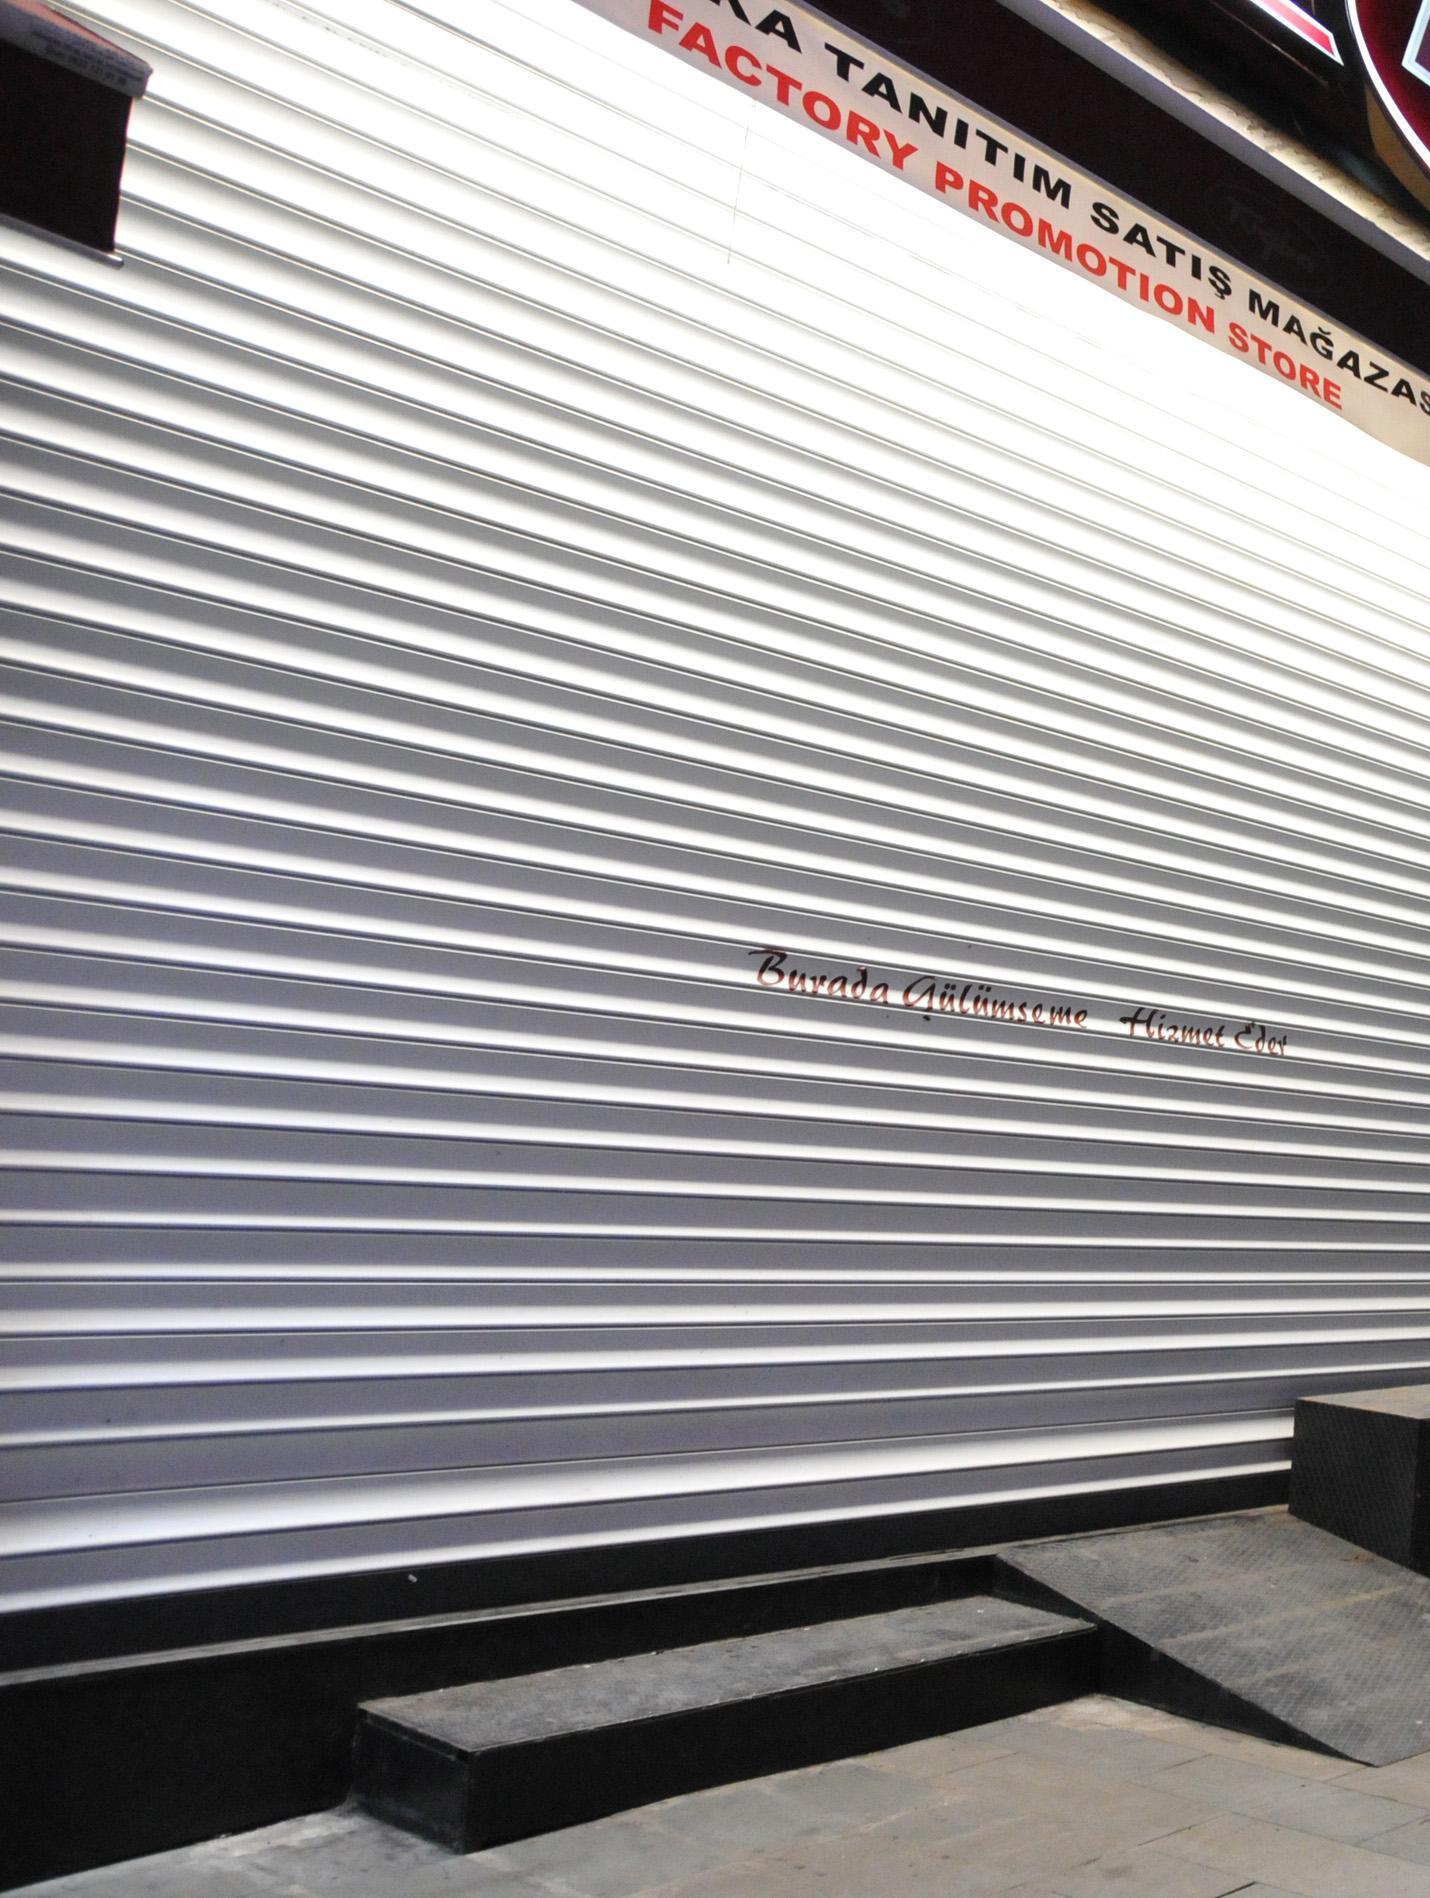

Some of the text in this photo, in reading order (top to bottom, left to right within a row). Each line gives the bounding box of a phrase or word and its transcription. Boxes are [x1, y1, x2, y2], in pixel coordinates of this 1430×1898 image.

[647, 0, 918, 171] FACTORY
[933, 160, 1216, 335] PROMOTION
[1228, 321, 1343, 410] STORE
[823, 43, 1074, 210] TANITIM
[1090, 201, 1233, 300] SATIŞ
[748, 945, 889, 1006] Burada
[1119, 1005, 1227, 1049] Hizmet
[1233, 1020, 1289, 1057] Eder
